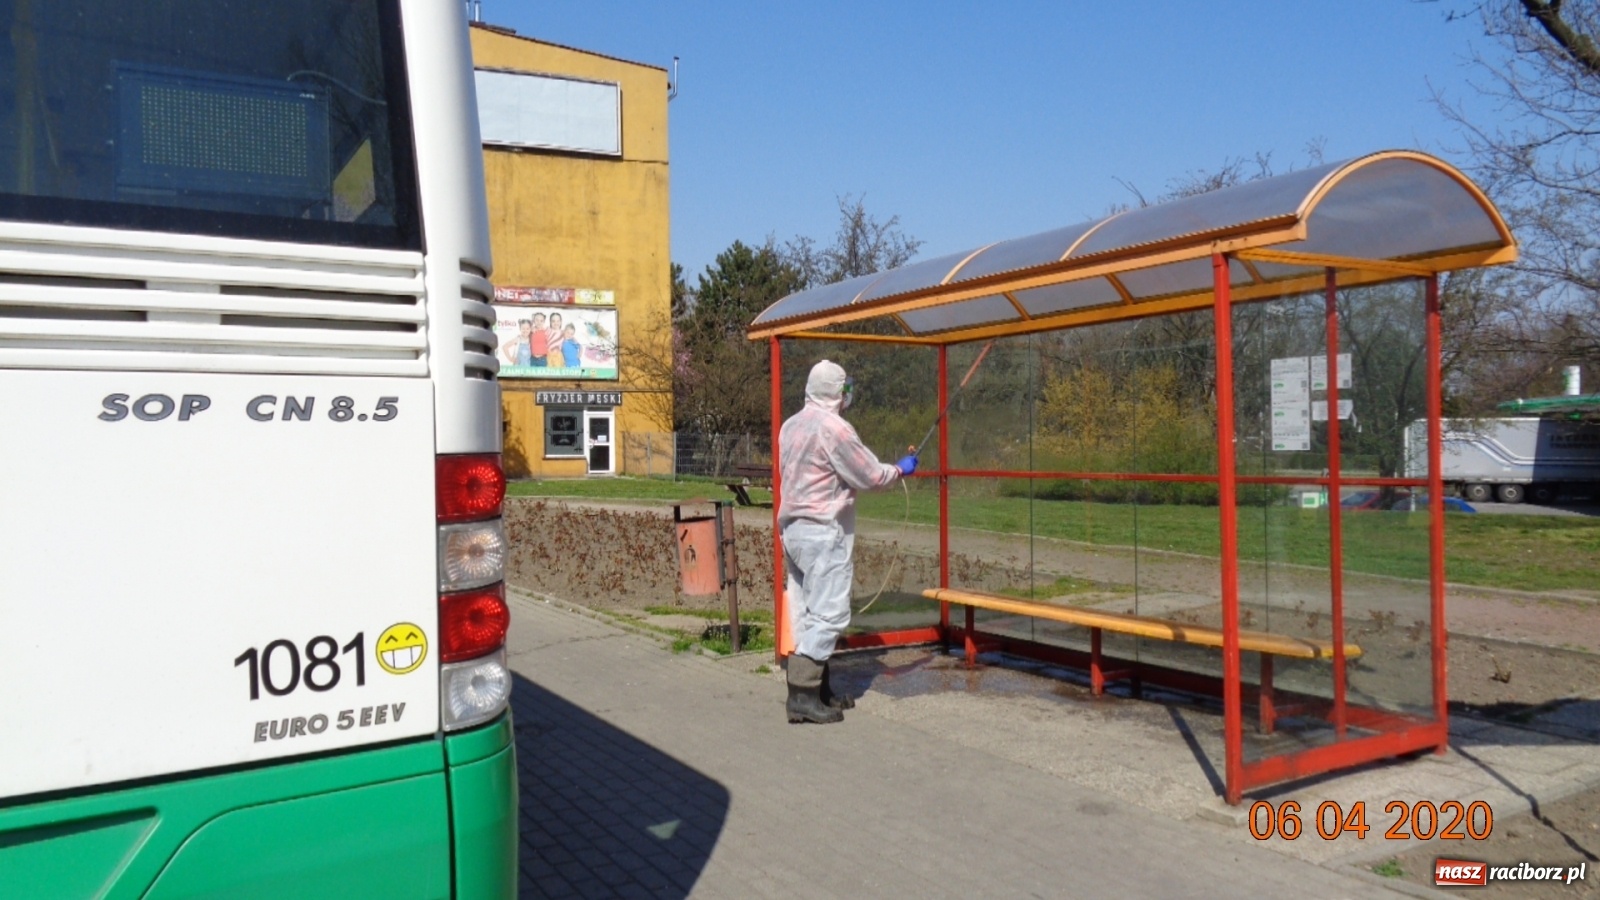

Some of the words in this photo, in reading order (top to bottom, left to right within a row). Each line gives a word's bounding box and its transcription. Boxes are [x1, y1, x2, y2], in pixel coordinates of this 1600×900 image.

[97, 393, 211, 422] SOP
[246, 395, 315, 421] CN
[327, 396, 399, 422] 8.5
[536, 393, 583, 404] FRYZJER
[234, 631, 365, 701] 1081
[253, 713, 329, 743] EURO
